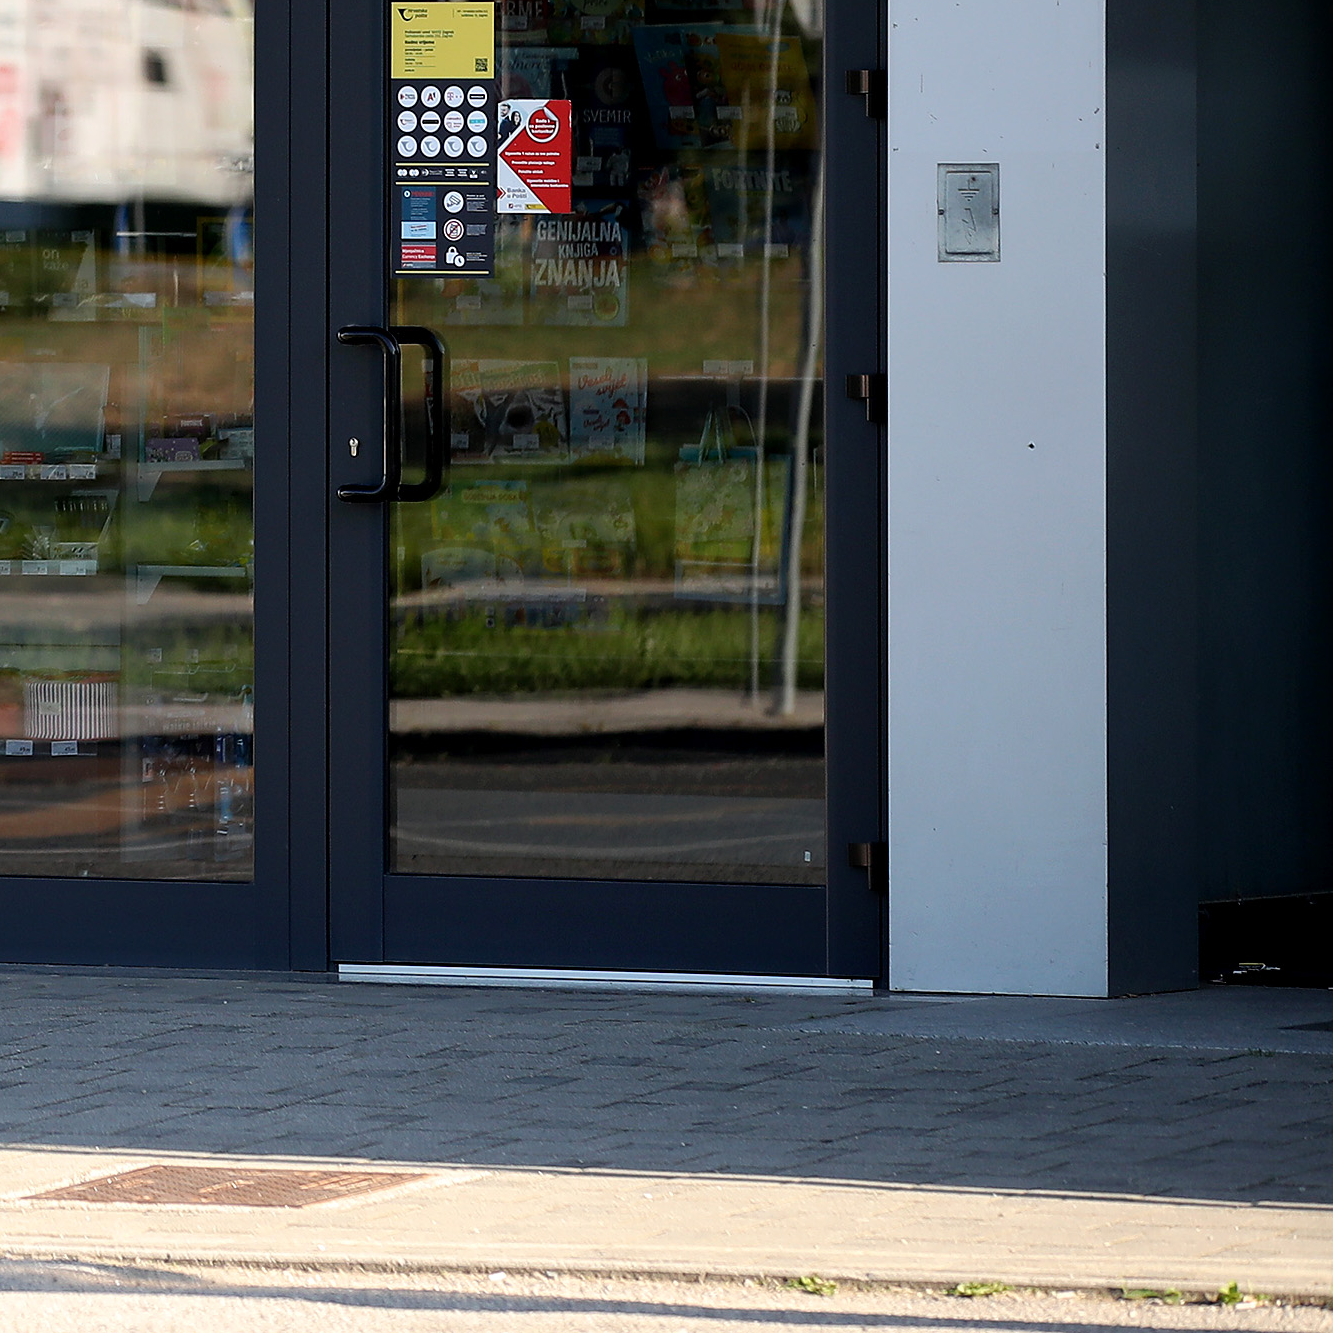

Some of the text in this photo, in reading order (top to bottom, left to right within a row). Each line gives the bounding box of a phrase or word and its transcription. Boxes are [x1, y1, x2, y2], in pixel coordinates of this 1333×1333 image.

[582, 108, 632, 124] SVEMIR
[537, 219, 622, 243] GENIJALNA
[558, 242, 599, 259] KNJIGA
[534, 258, 621, 288] ZNANJA
